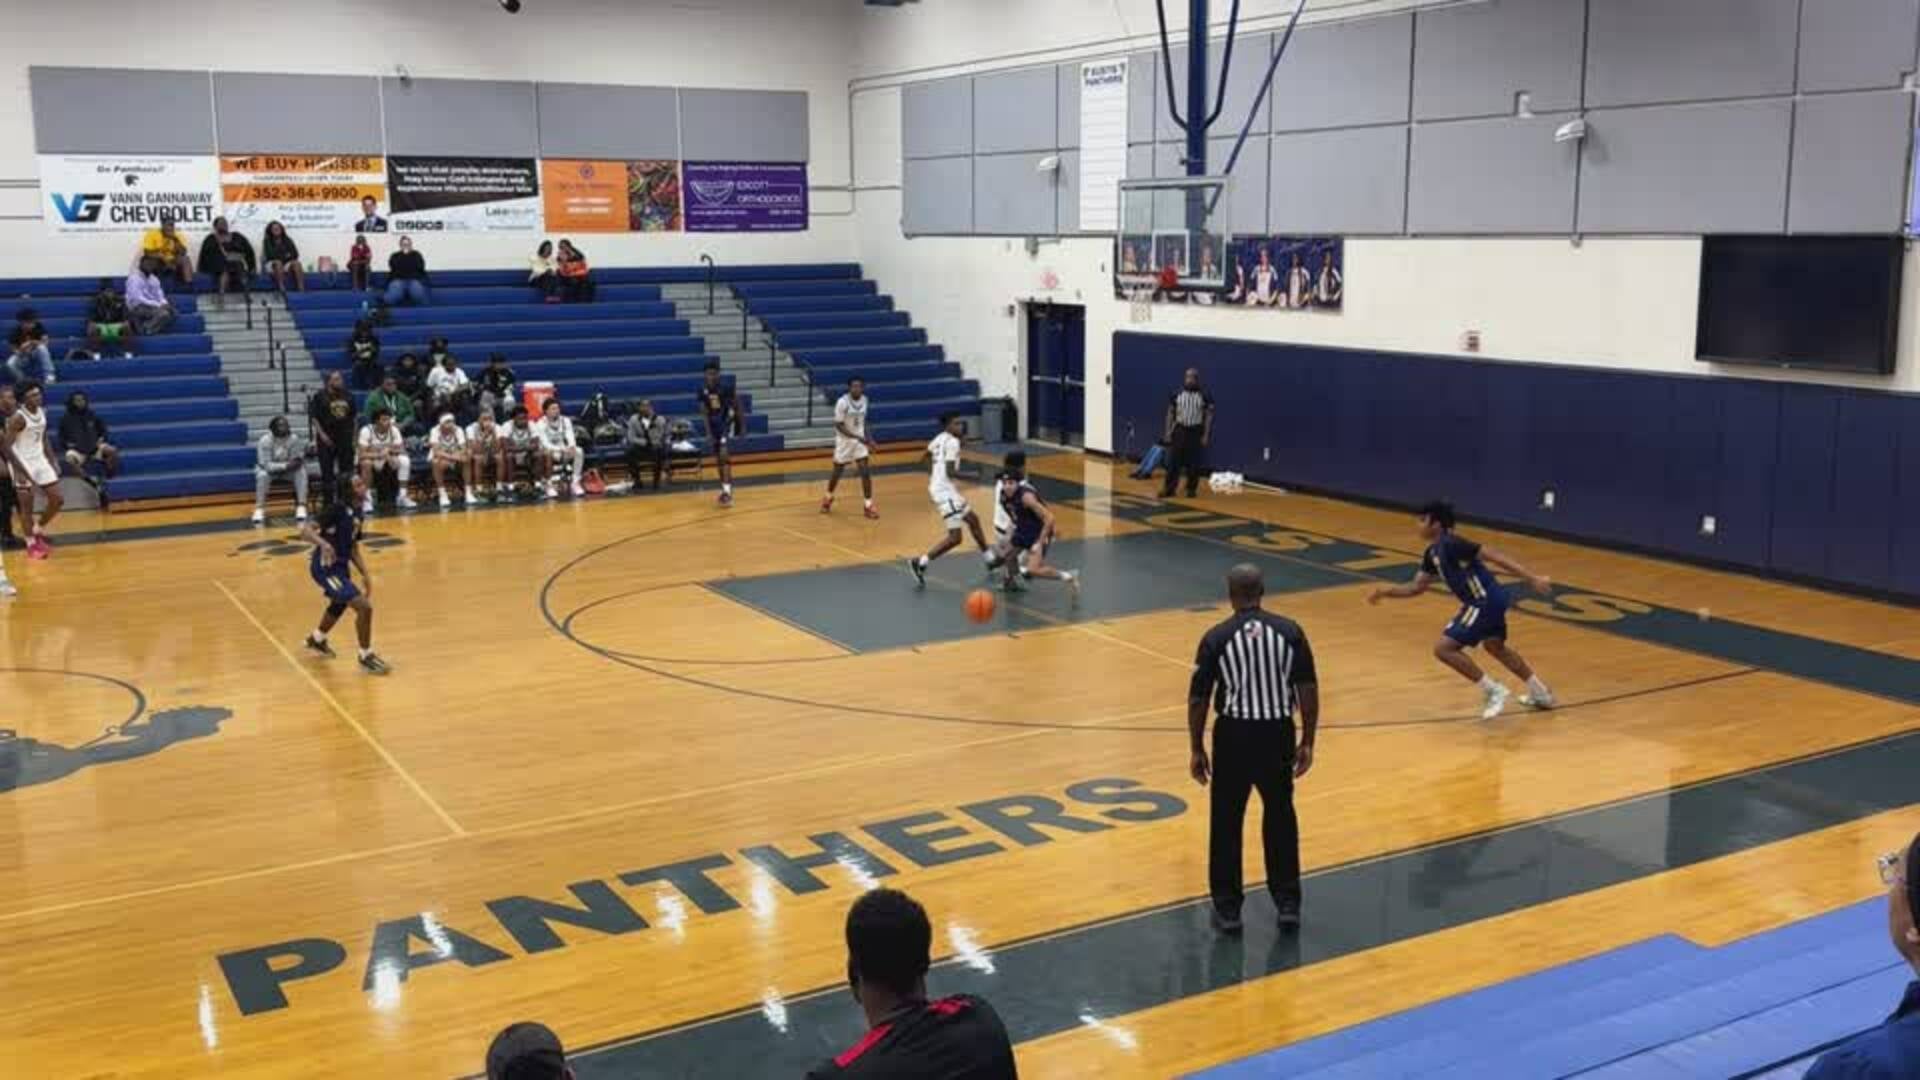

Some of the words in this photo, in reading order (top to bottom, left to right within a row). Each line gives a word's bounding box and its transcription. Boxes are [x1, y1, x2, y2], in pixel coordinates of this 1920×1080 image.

[235, 158, 258, 170] WE
[265, 158, 299, 170] BUY
[110, 193, 142, 204] VANN
[146, 193, 213, 204] GANNAWAY
[110, 205, 213, 223] CHEVROLET
[1082, 492, 1653, 622] EUSTS
[217, 777, 1187, 1016] PANTHERS
